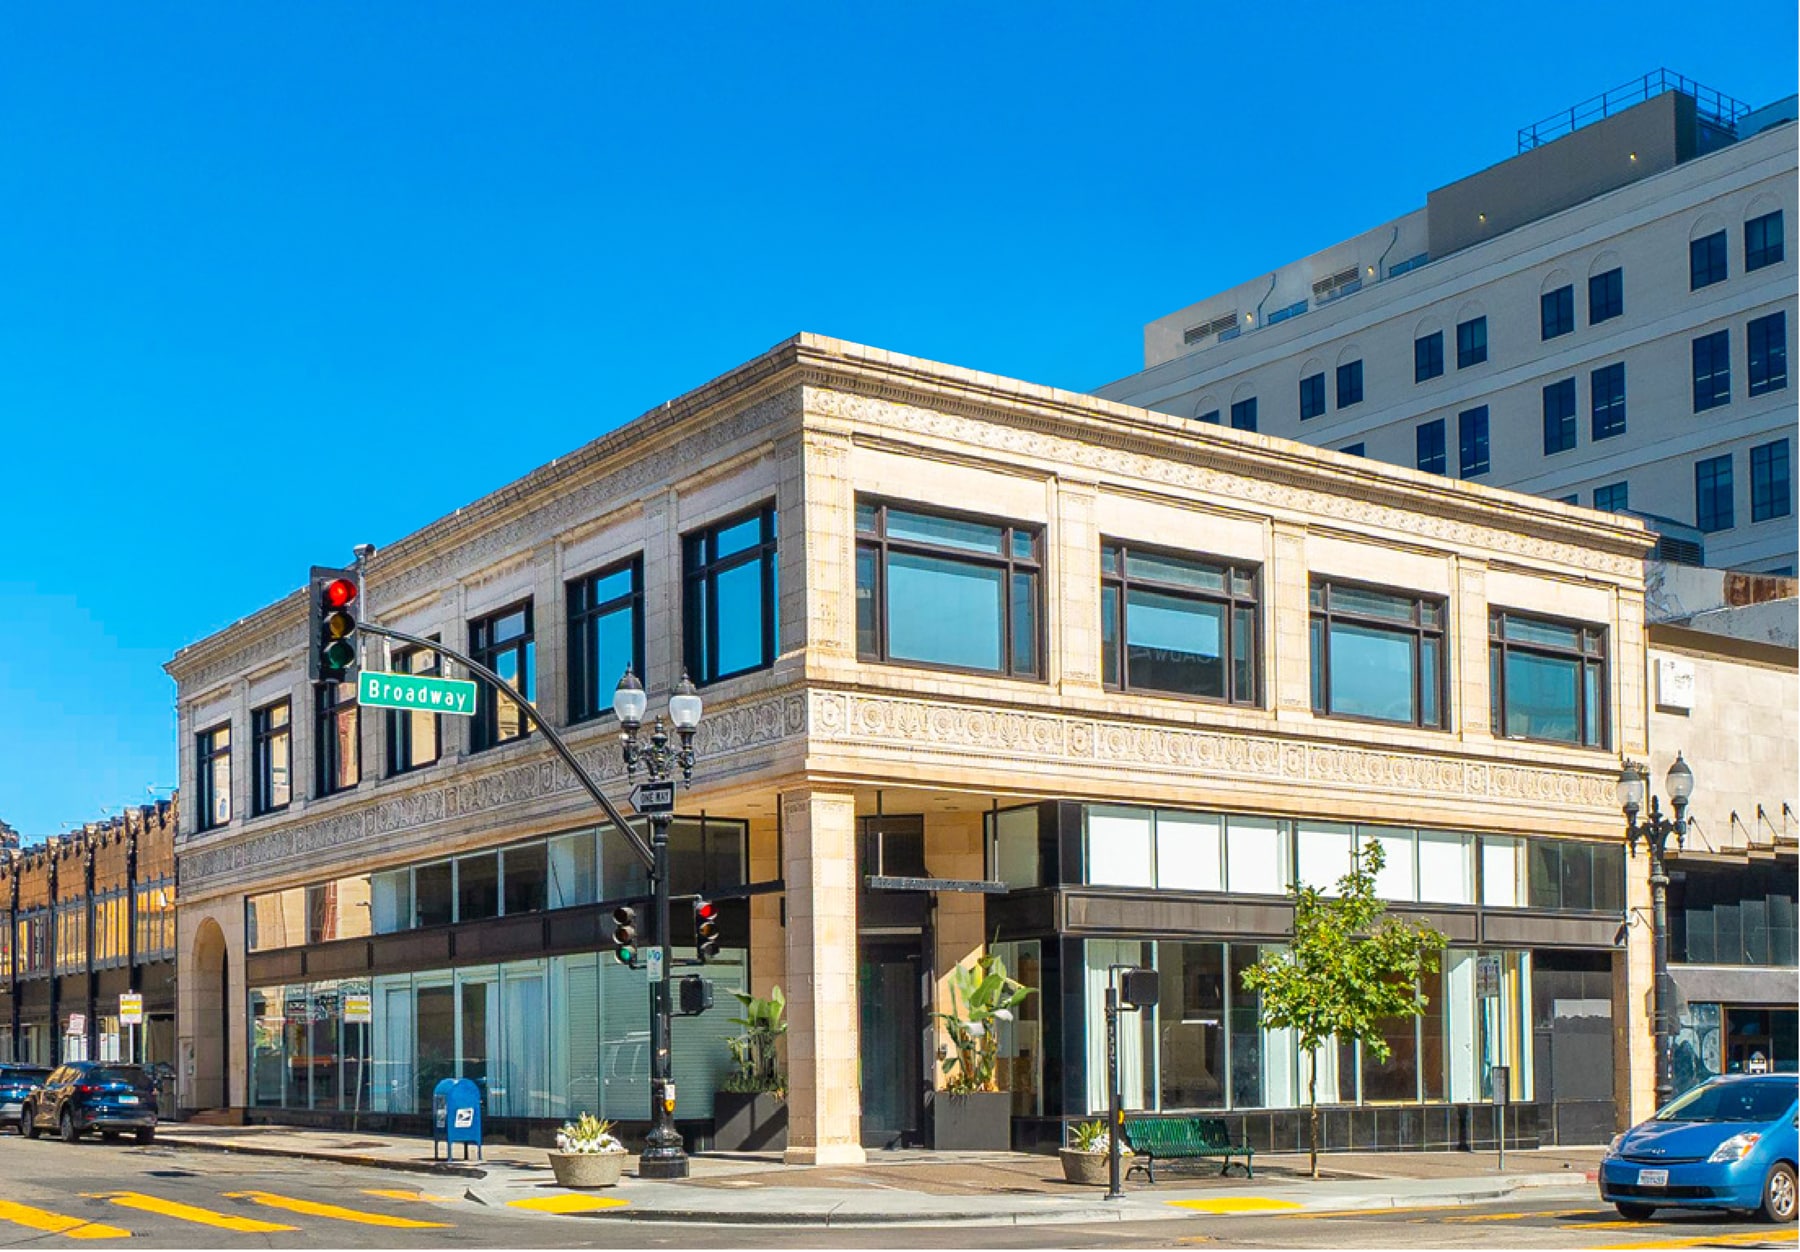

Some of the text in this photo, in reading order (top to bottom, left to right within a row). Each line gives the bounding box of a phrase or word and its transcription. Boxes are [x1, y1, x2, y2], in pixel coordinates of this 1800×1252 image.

[369, 679, 467, 711] Broadway
[640, 791, 669, 804] ONE WAY
